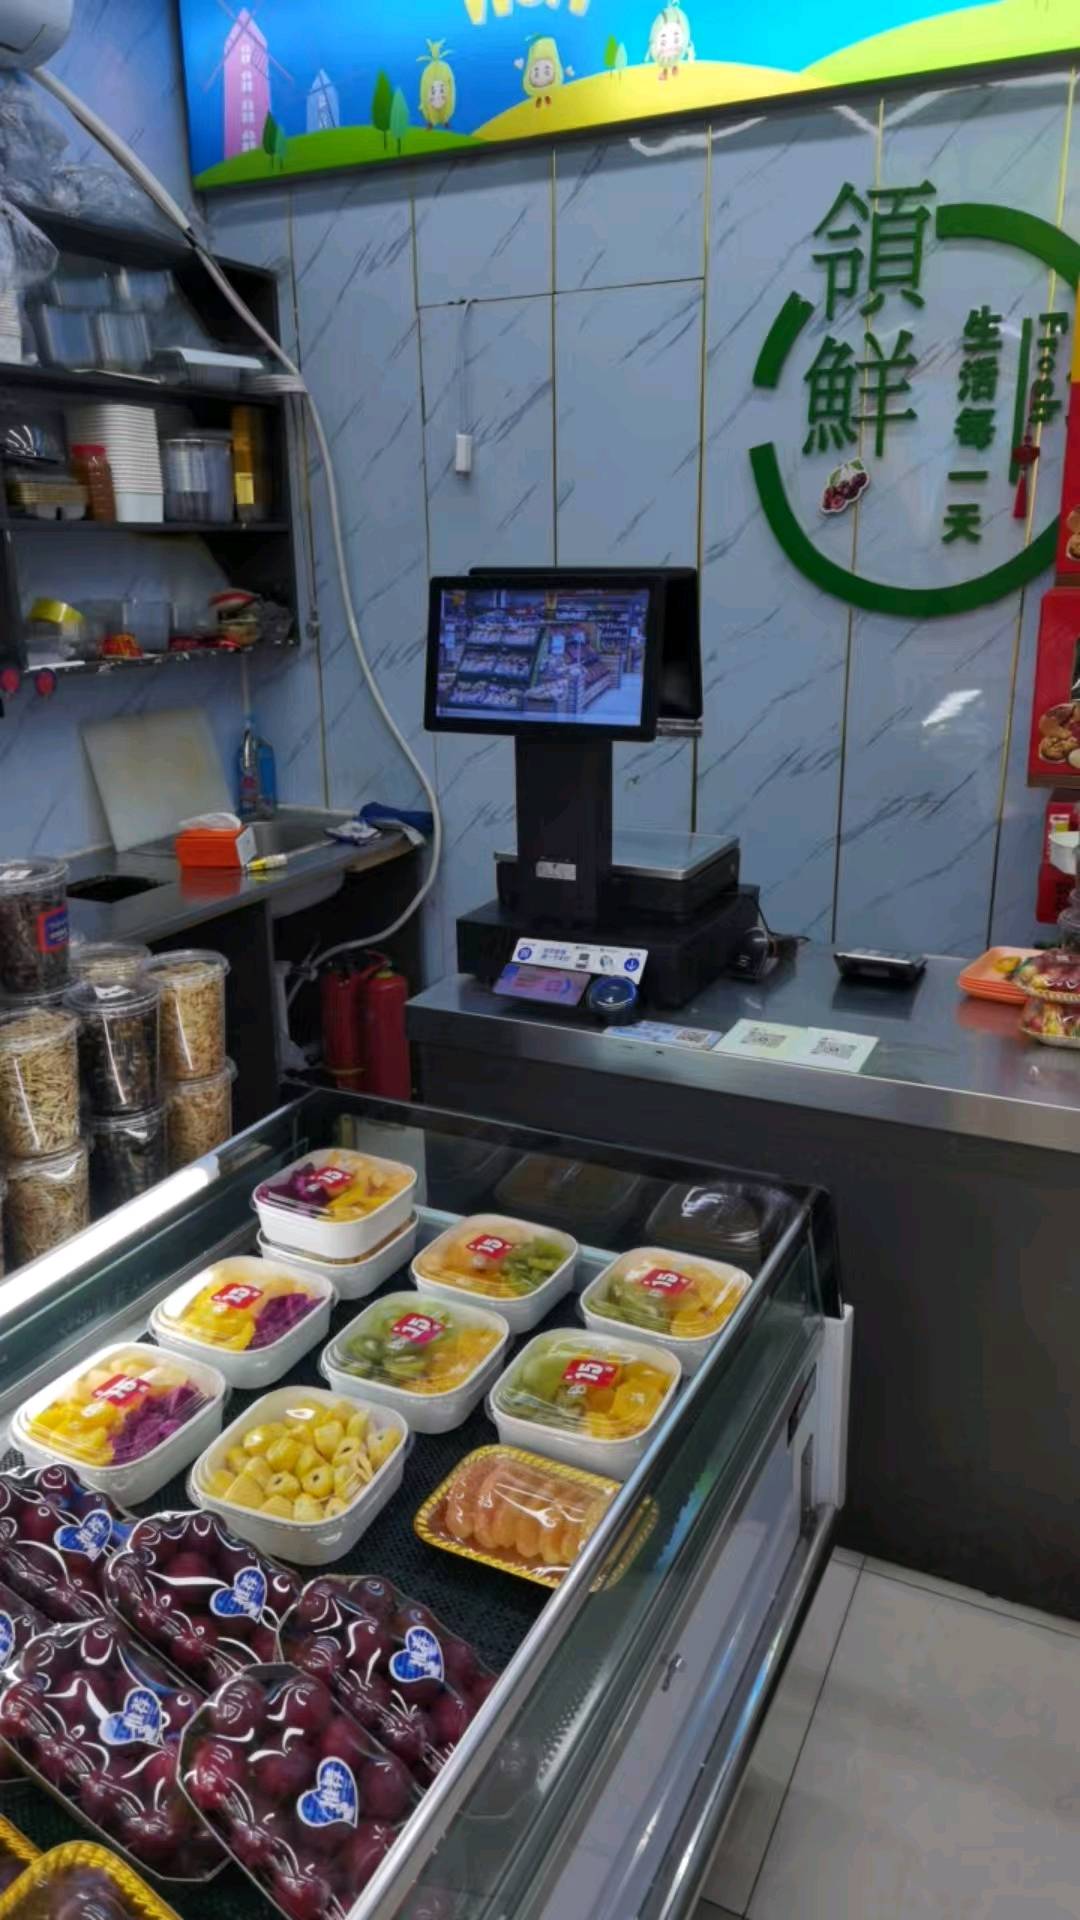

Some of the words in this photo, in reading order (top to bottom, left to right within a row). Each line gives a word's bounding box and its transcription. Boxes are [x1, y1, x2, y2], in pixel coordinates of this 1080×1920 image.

[942, 305, 1001, 544] 生活每一天
[575, 1363, 604, 1381] 15
